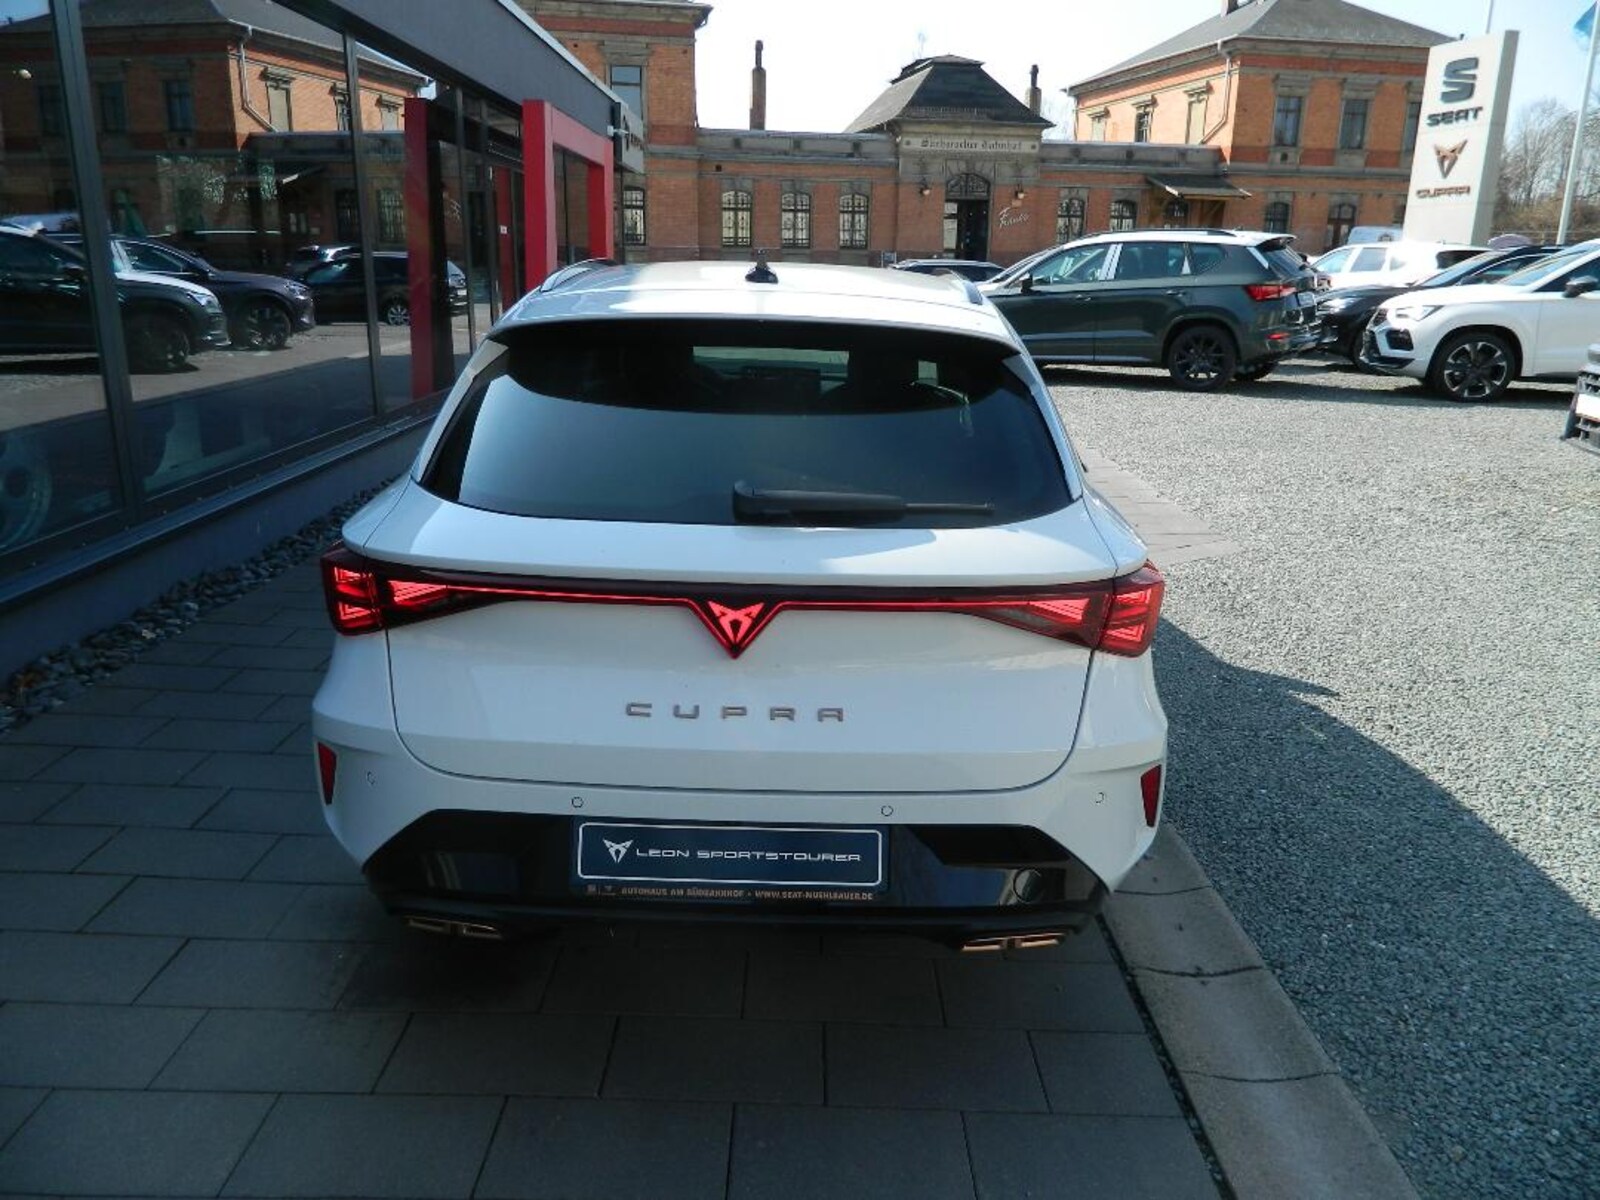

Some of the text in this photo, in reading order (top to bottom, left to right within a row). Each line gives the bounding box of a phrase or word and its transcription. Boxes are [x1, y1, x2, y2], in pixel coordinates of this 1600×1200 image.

[1427, 106, 1483, 127] SEAT
[1416, 185, 1471, 198] CUPRA
[626, 702, 844, 722] CUPRA
[635, 848, 861, 862] LEON SPORTSTOURER
[621, 887, 668, 896] AUTOHAUS
[670, 888, 684, 896] AM
